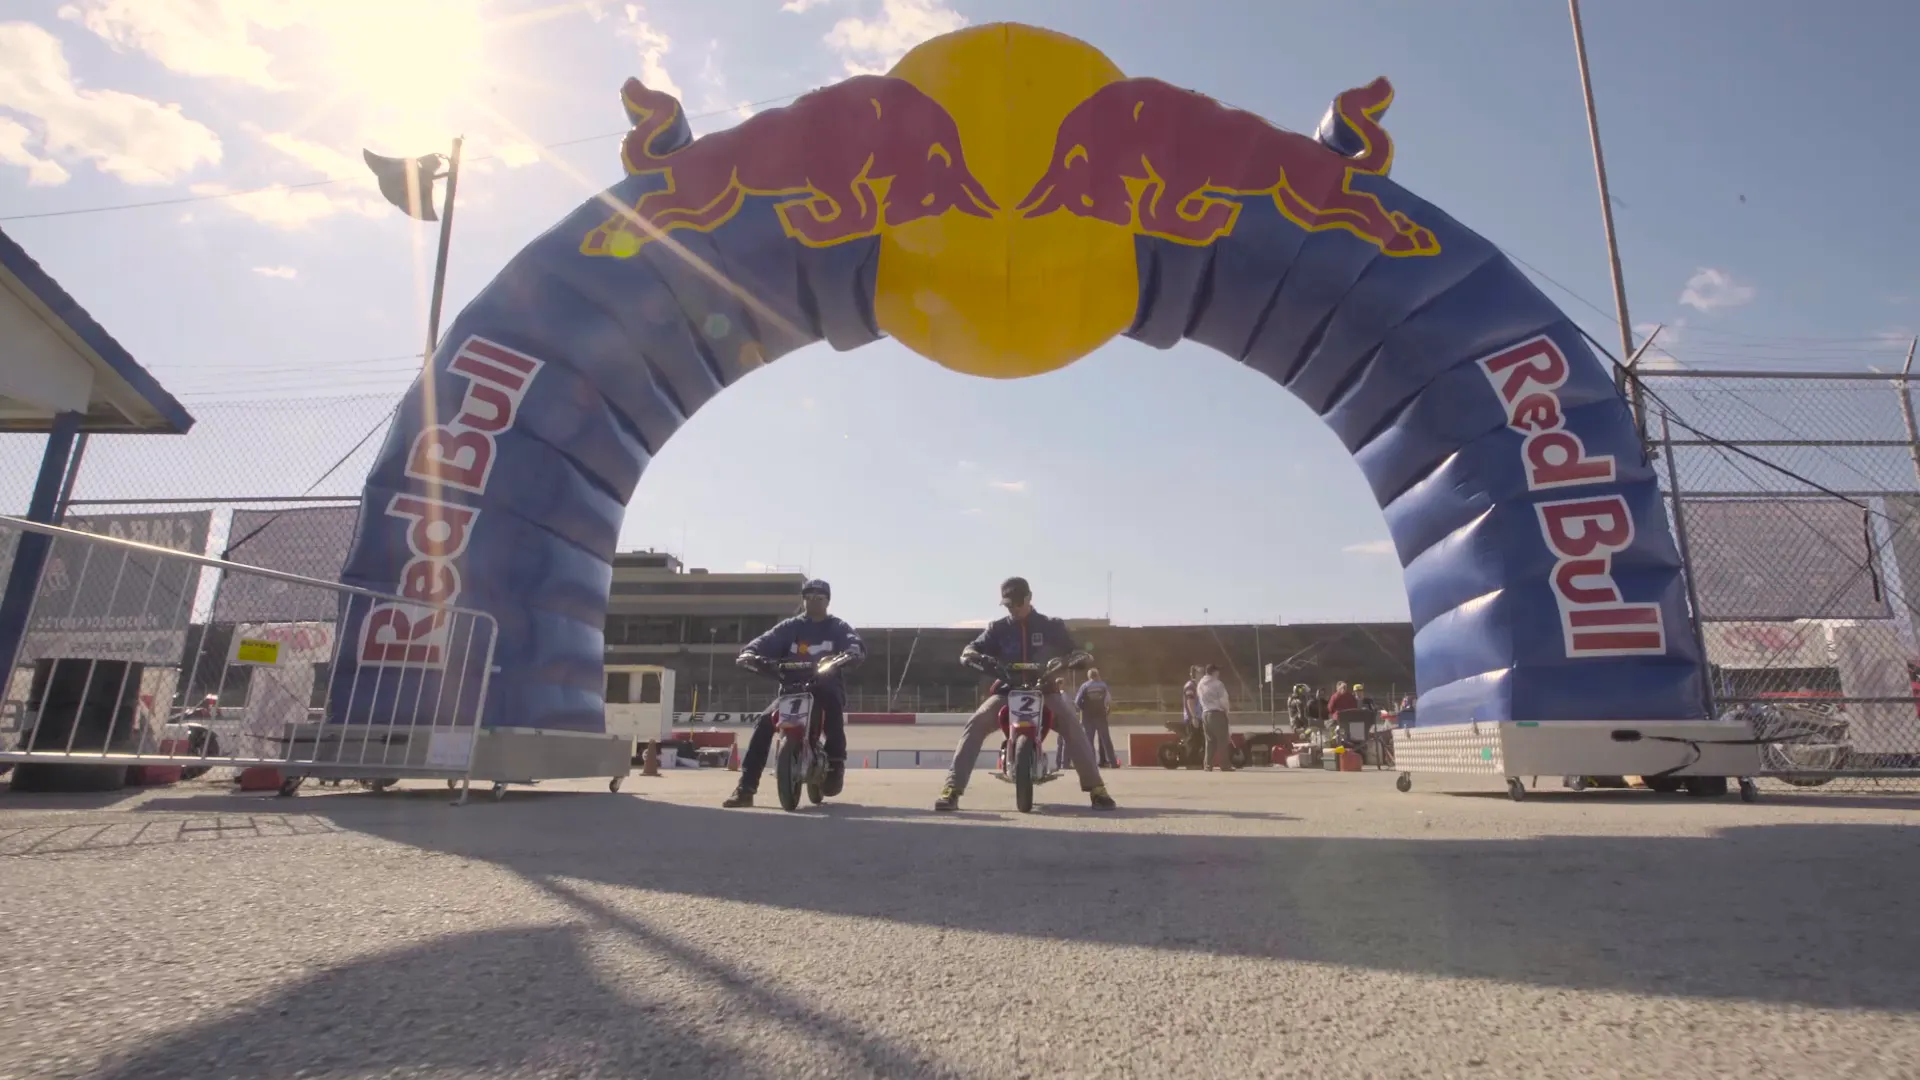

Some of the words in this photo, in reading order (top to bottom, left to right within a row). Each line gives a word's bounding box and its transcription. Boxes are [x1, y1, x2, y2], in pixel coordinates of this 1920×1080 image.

[405, 336, 545, 493] Bull
[1477, 335, 1615, 490] Red
[358, 494, 480, 668] Red
[1535, 495, 1665, 656] Bull
[790, 699, 802, 714] 1
[1019, 696, 1035, 712] 2
